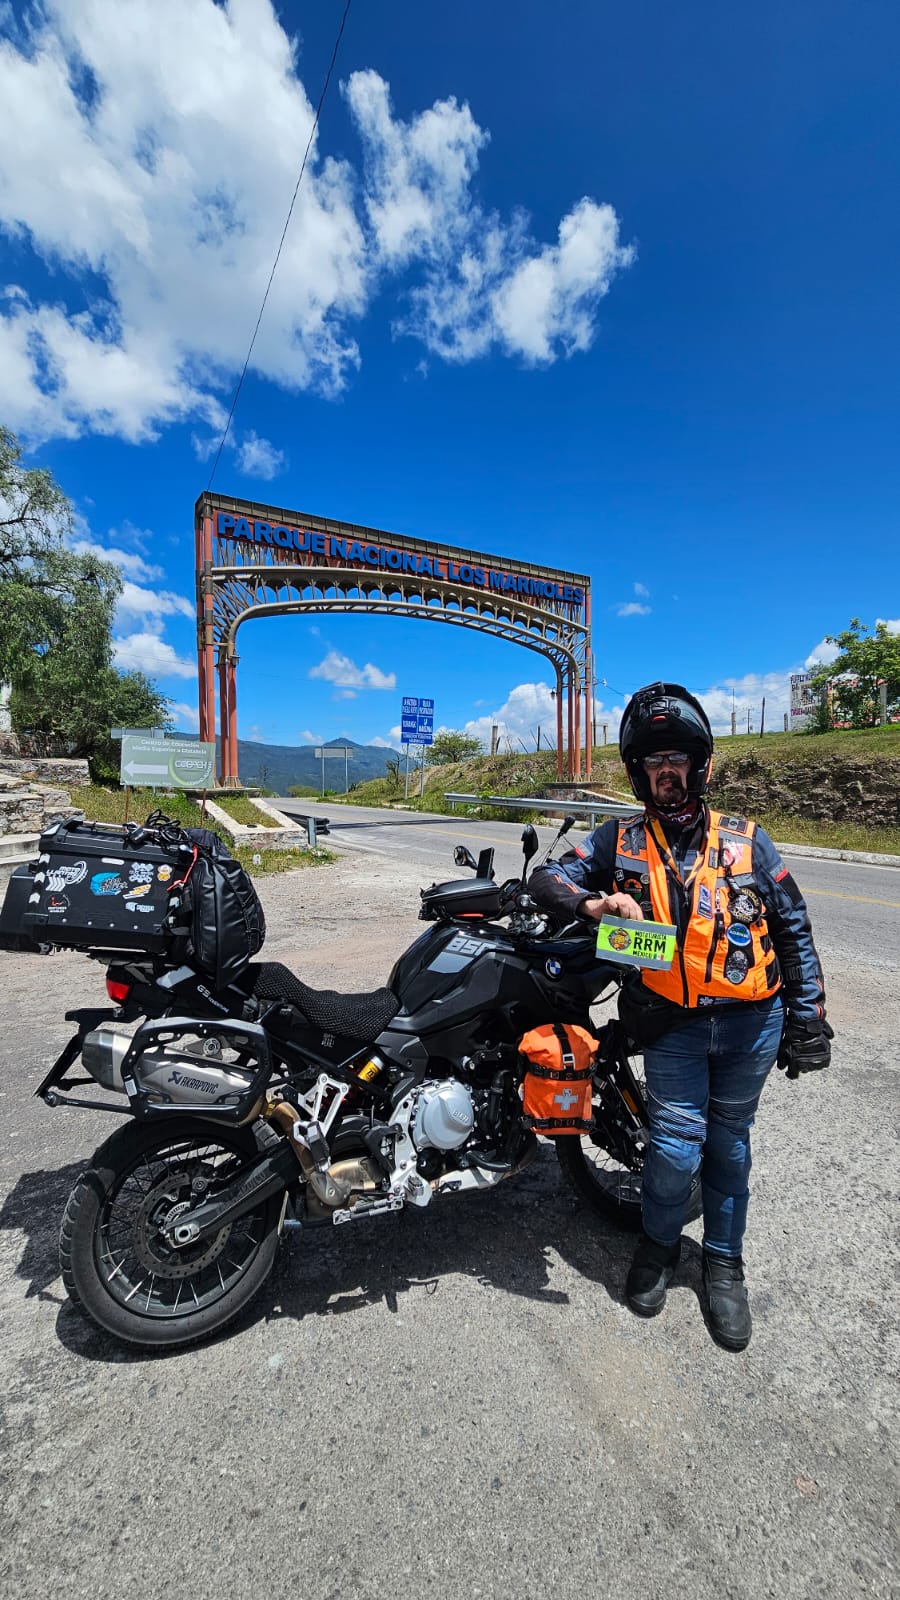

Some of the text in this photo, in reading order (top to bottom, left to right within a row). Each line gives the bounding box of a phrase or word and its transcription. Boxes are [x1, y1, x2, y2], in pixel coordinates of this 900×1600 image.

[217, 512, 585, 604] PARQUE NACIONAL LOS MARMOLES
[633, 937, 667, 953] RRM
[196, 984, 211, 998] GS
